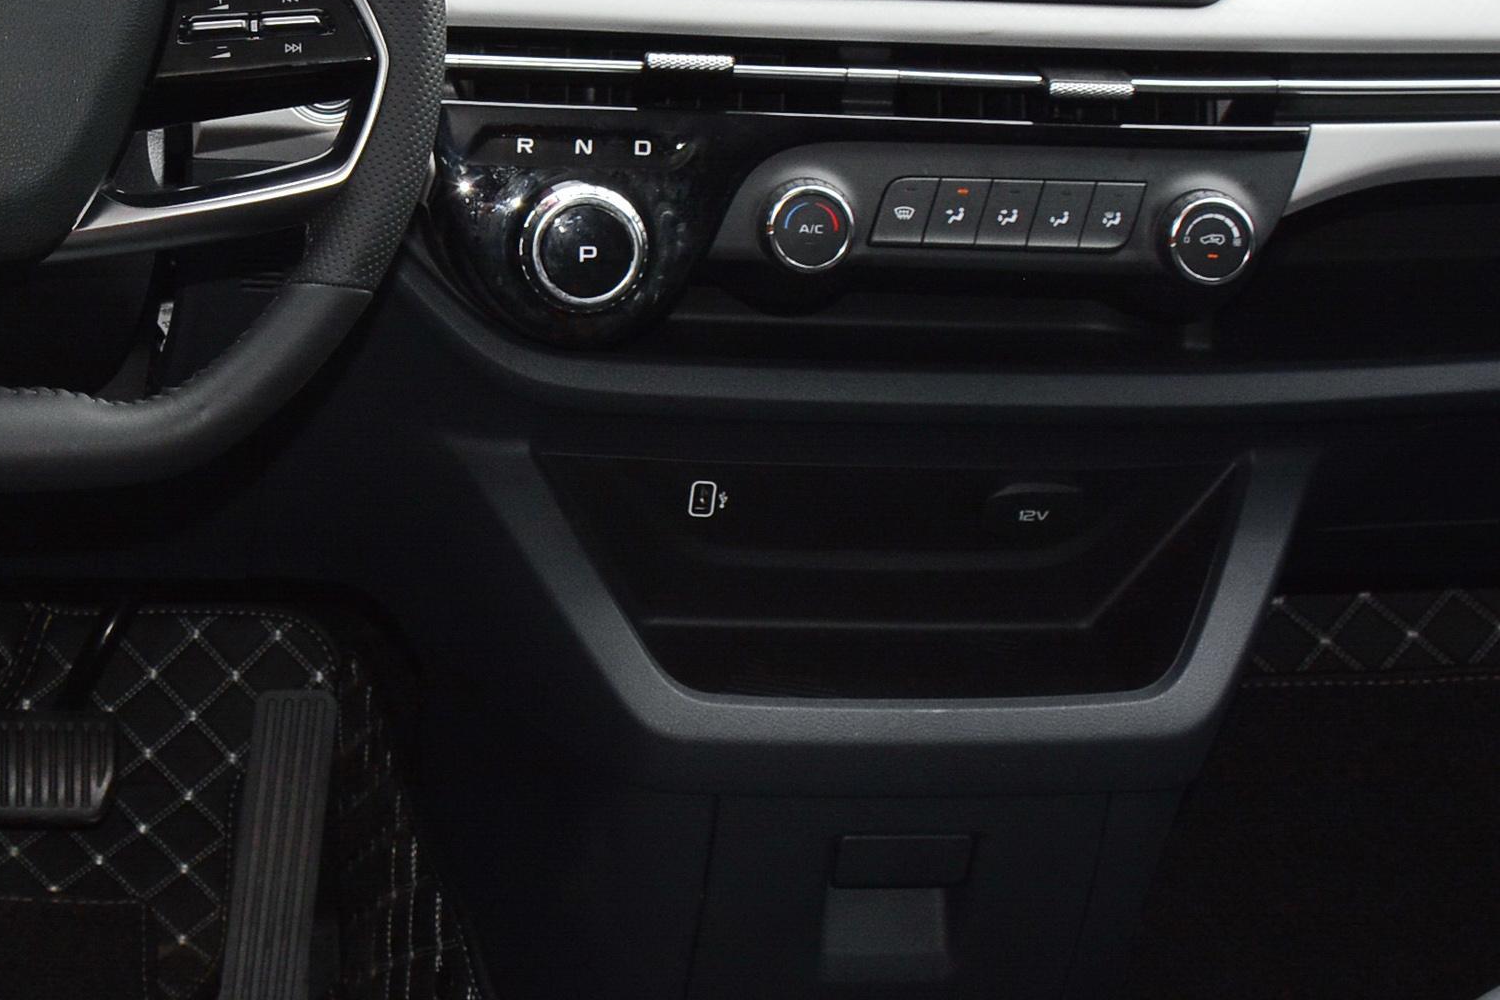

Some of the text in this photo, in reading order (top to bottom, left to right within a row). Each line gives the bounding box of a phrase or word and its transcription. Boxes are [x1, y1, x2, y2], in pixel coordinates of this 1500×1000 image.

[516, 137, 652, 156] R N D
[799, 224, 824, 235] A/C
[579, 245, 598, 263] P
[1018, 509, 1050, 522] 12V
